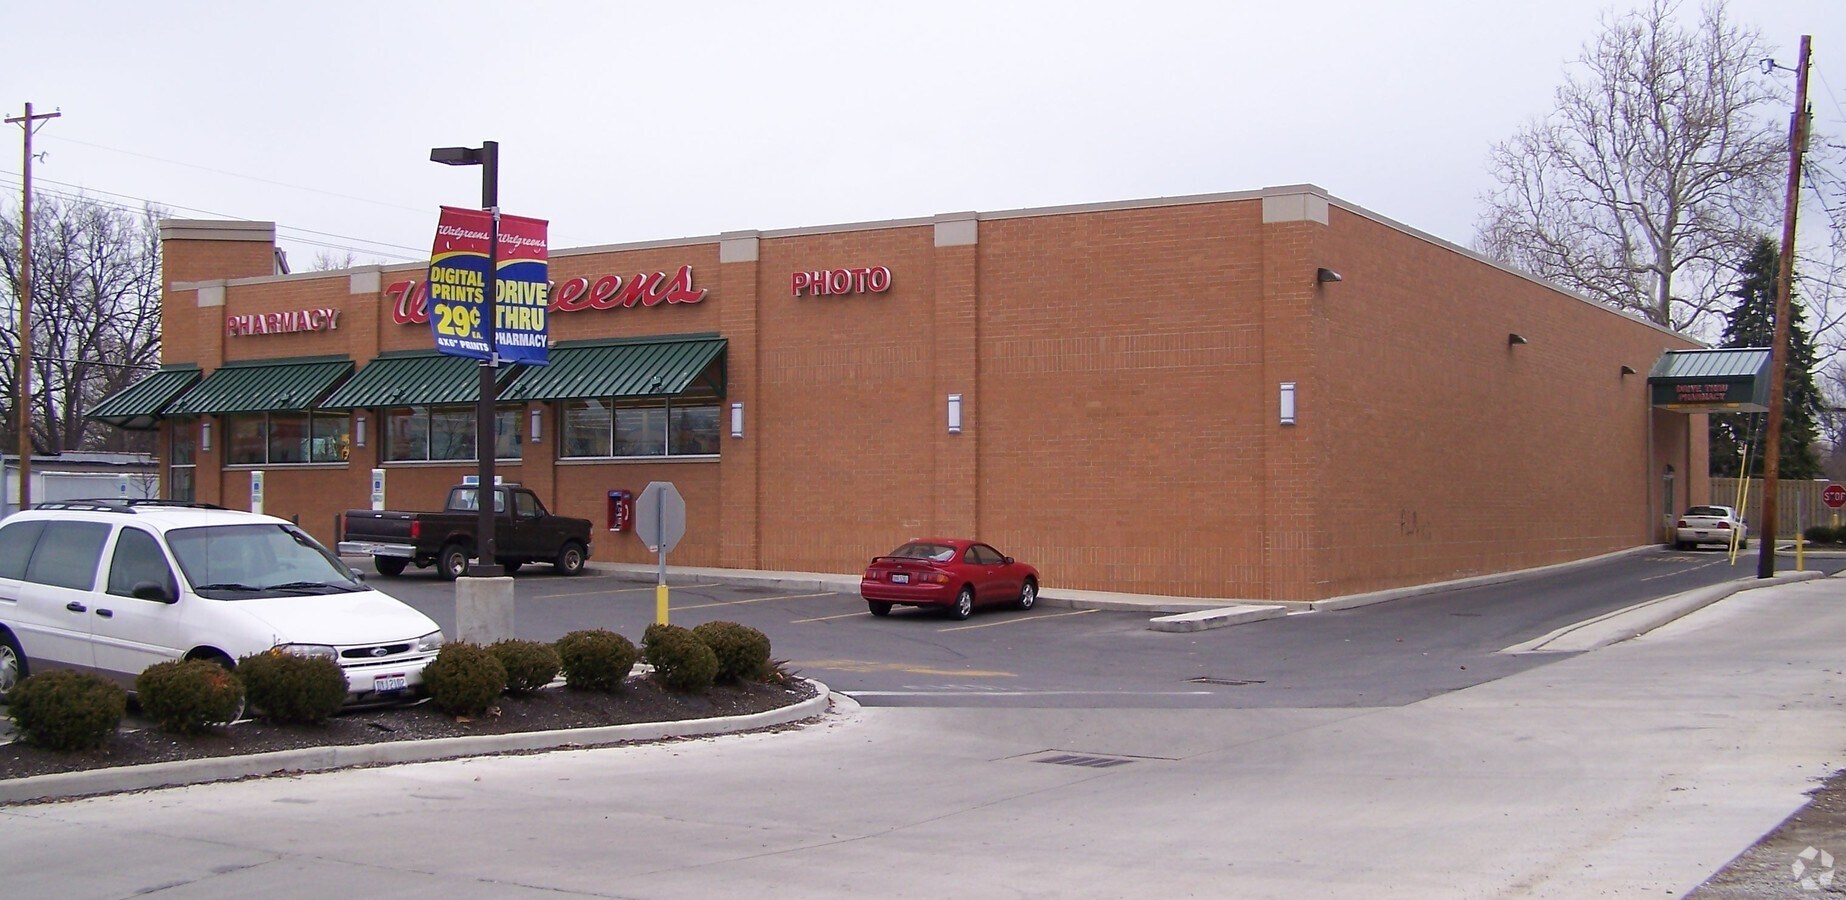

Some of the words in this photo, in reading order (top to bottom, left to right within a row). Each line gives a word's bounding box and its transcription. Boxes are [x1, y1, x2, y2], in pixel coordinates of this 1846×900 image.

[438, 224, 490, 240] Walgreens
[498, 233, 547, 248] Walgreens
[430, 266, 485, 288] DIGITAL
[791, 265, 892, 297] PHOTO
[385, 264, 708, 325] Weens
[431, 283, 484, 304] PRINTS
[495, 278, 548, 307] DRIVE
[226, 307, 341, 337] PHARMACY
[434, 303, 481, 338] 29¢
[495, 304, 545, 332] THRU
[460, 338, 490, 352] PRINTS
[1824, 491, 1846, 501] STOP
